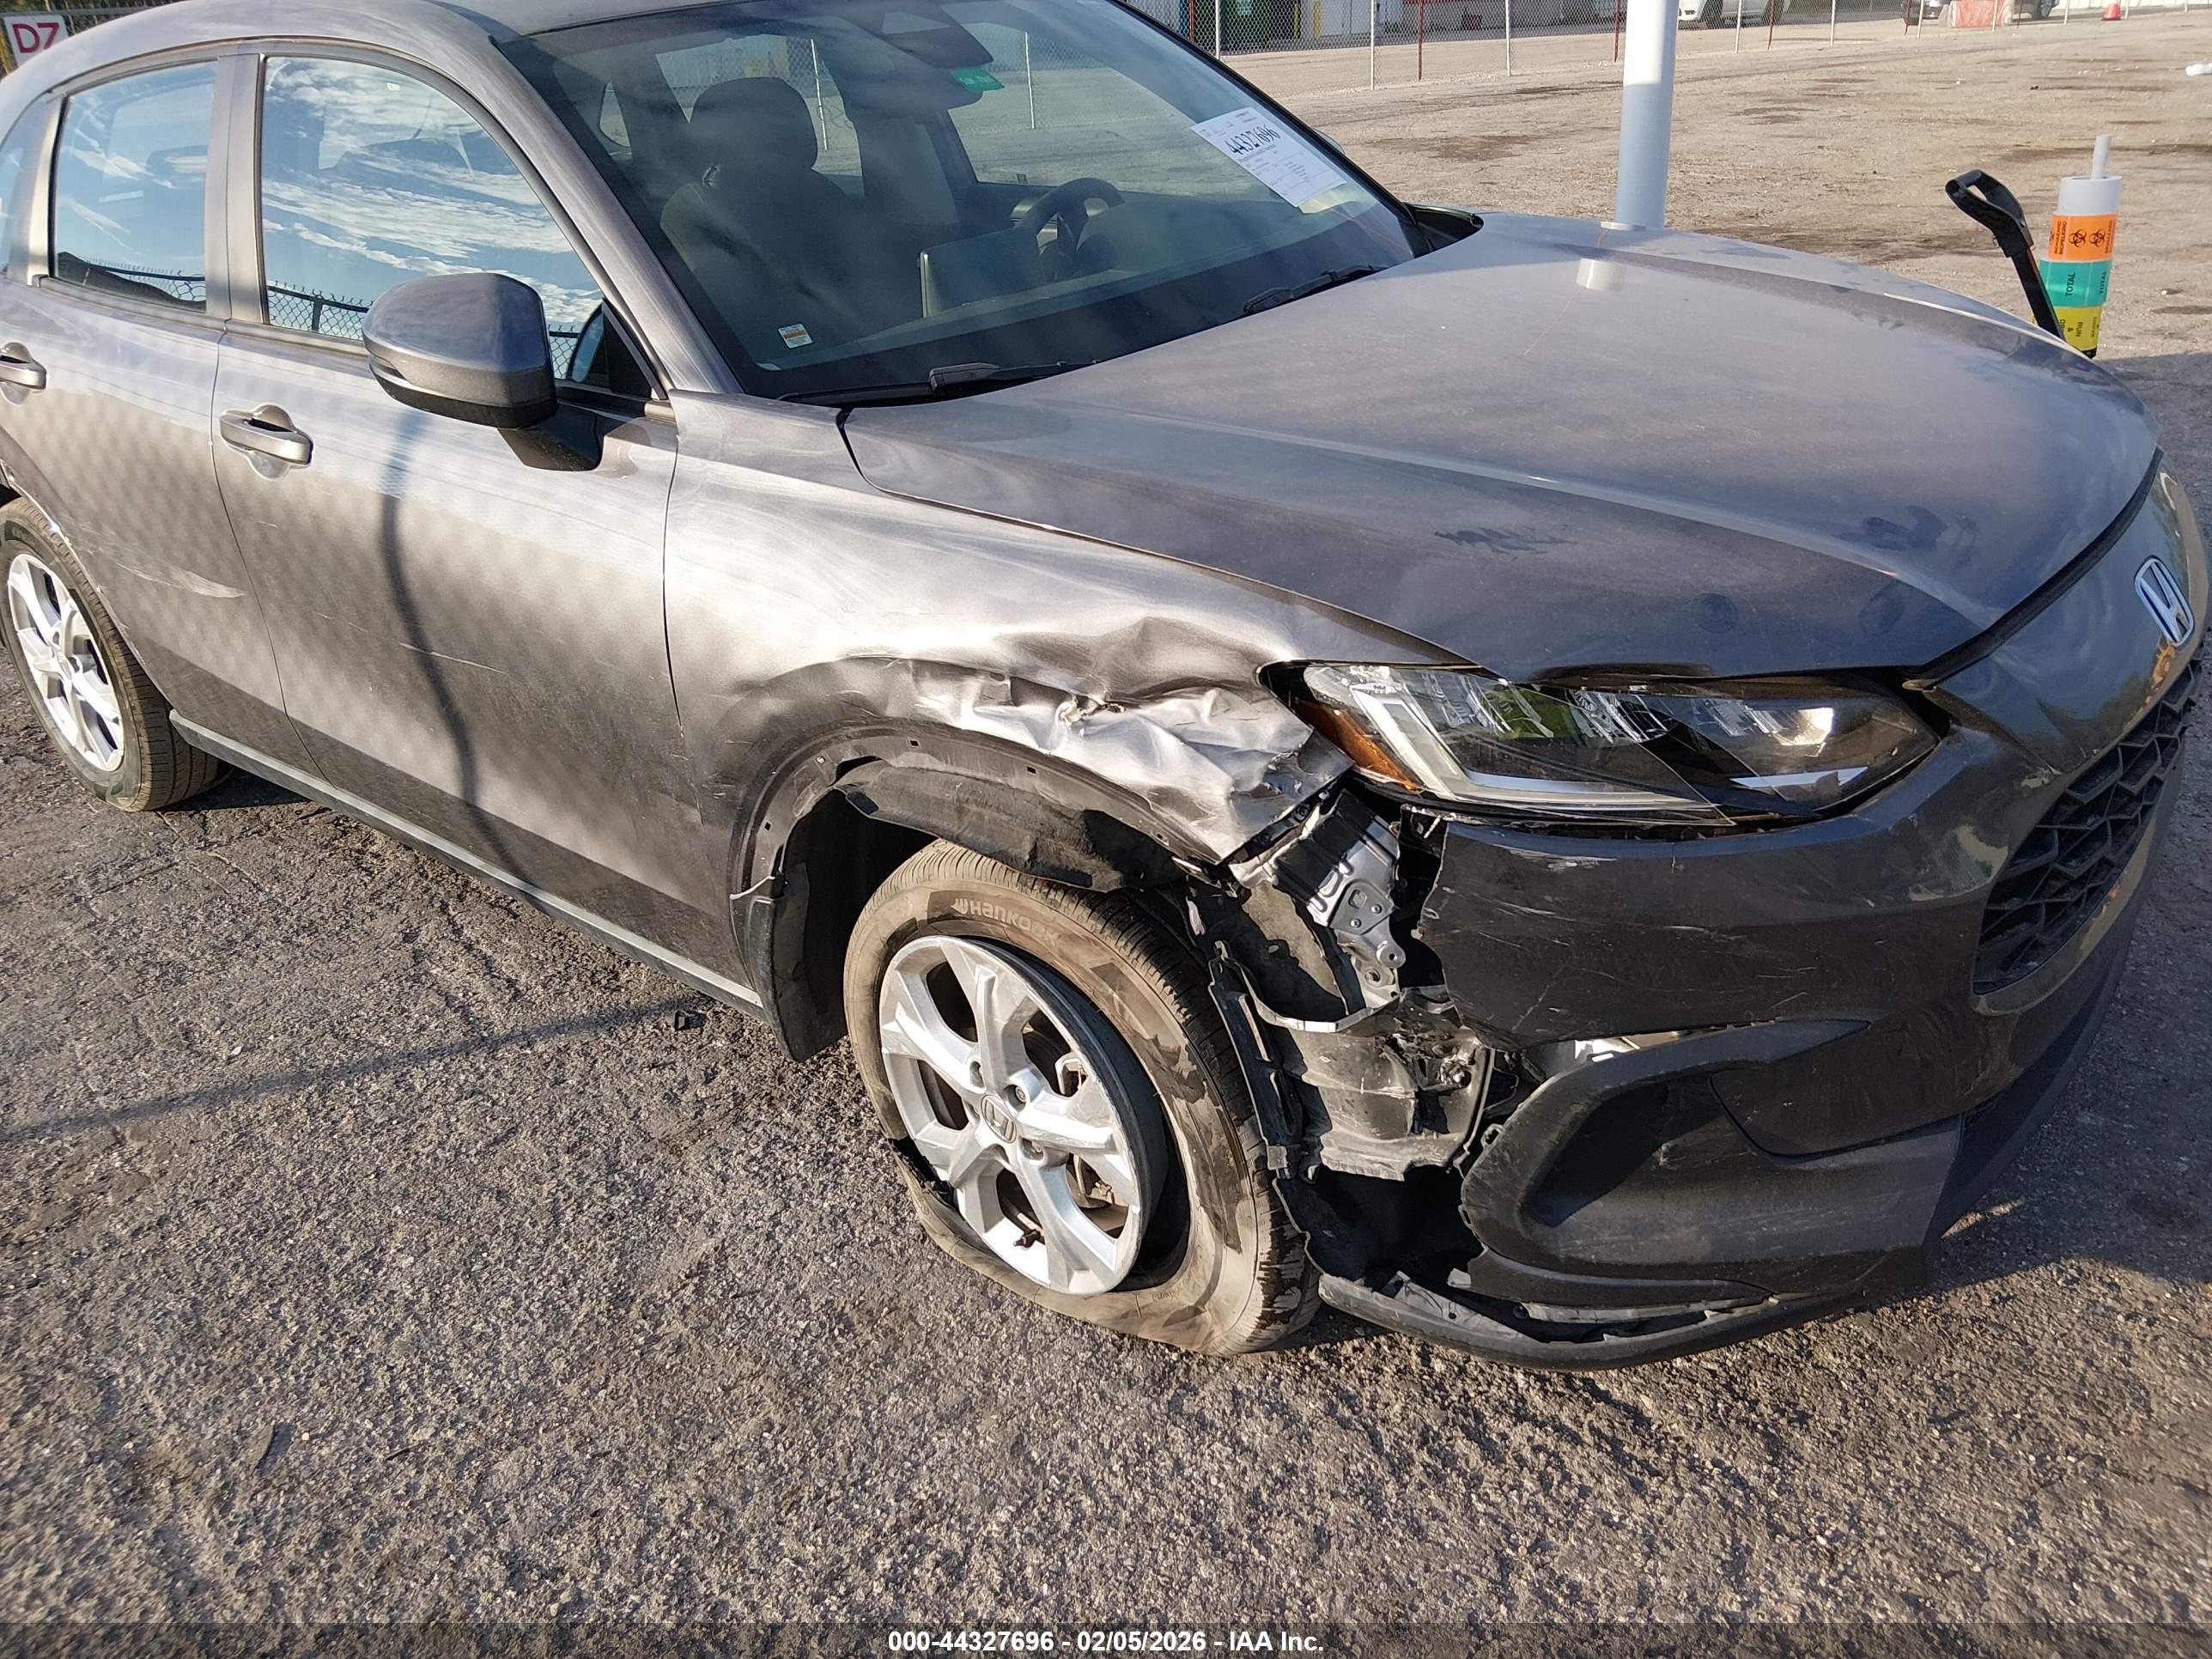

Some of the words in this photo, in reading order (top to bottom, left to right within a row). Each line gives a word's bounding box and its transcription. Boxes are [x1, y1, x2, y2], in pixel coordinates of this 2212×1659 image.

[13, 22, 59, 53] D7
[1224, 124, 1281, 155] 44327696
[2065, 272, 2075, 296] TOTAL
[2075, 321, 2083, 337] RUN
